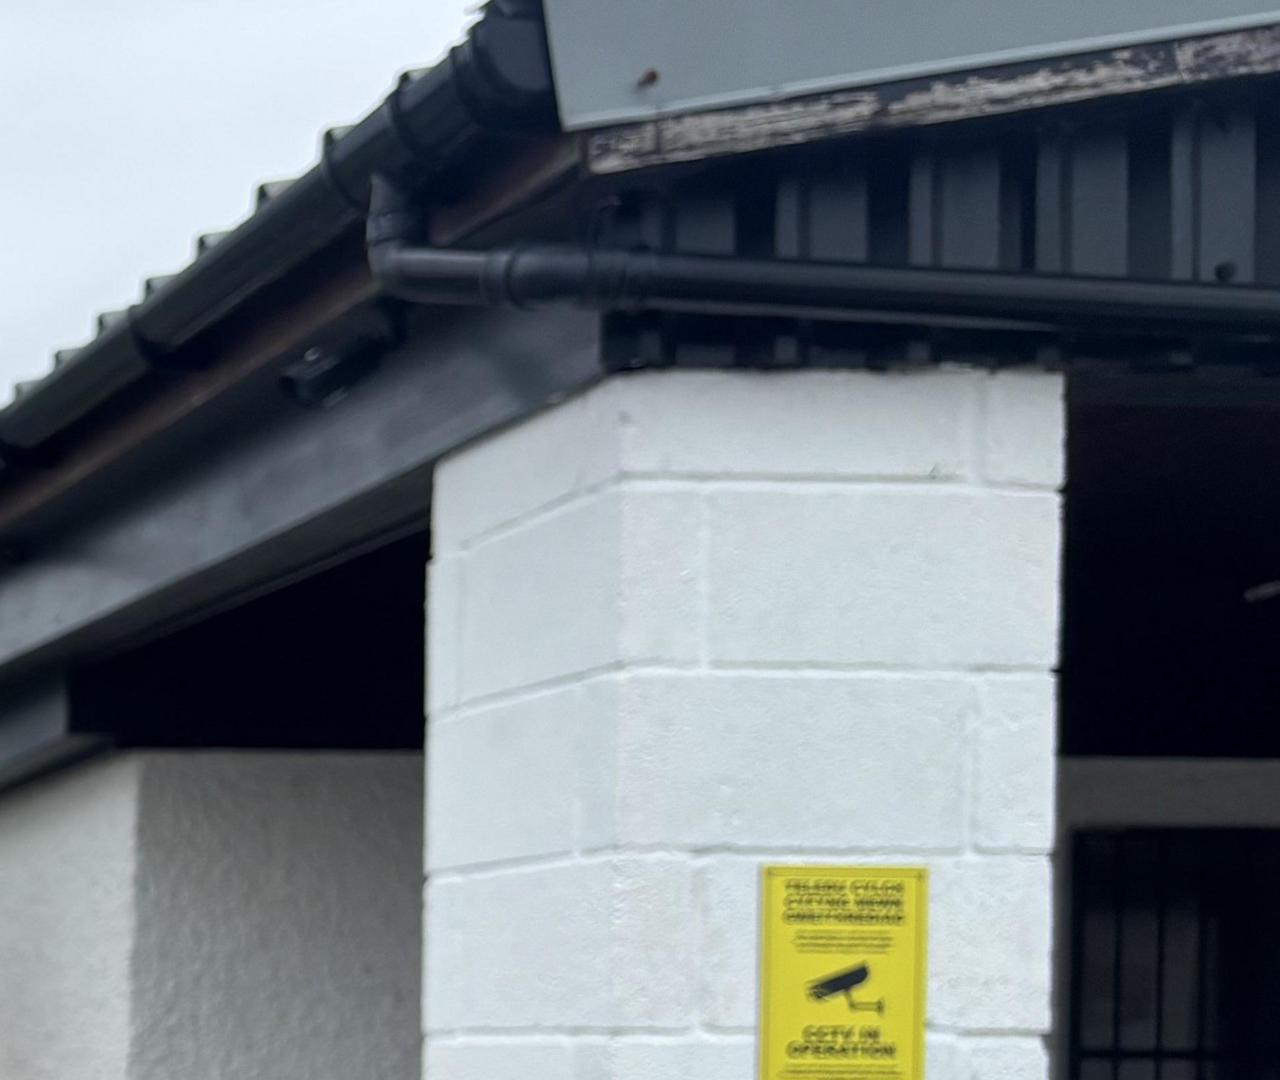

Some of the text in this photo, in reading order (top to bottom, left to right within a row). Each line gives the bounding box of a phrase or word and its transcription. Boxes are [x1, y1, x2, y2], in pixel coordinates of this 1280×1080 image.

[802, 1026, 880, 1042] CCTV IN
[786, 1042, 896, 1059] OPERATION
